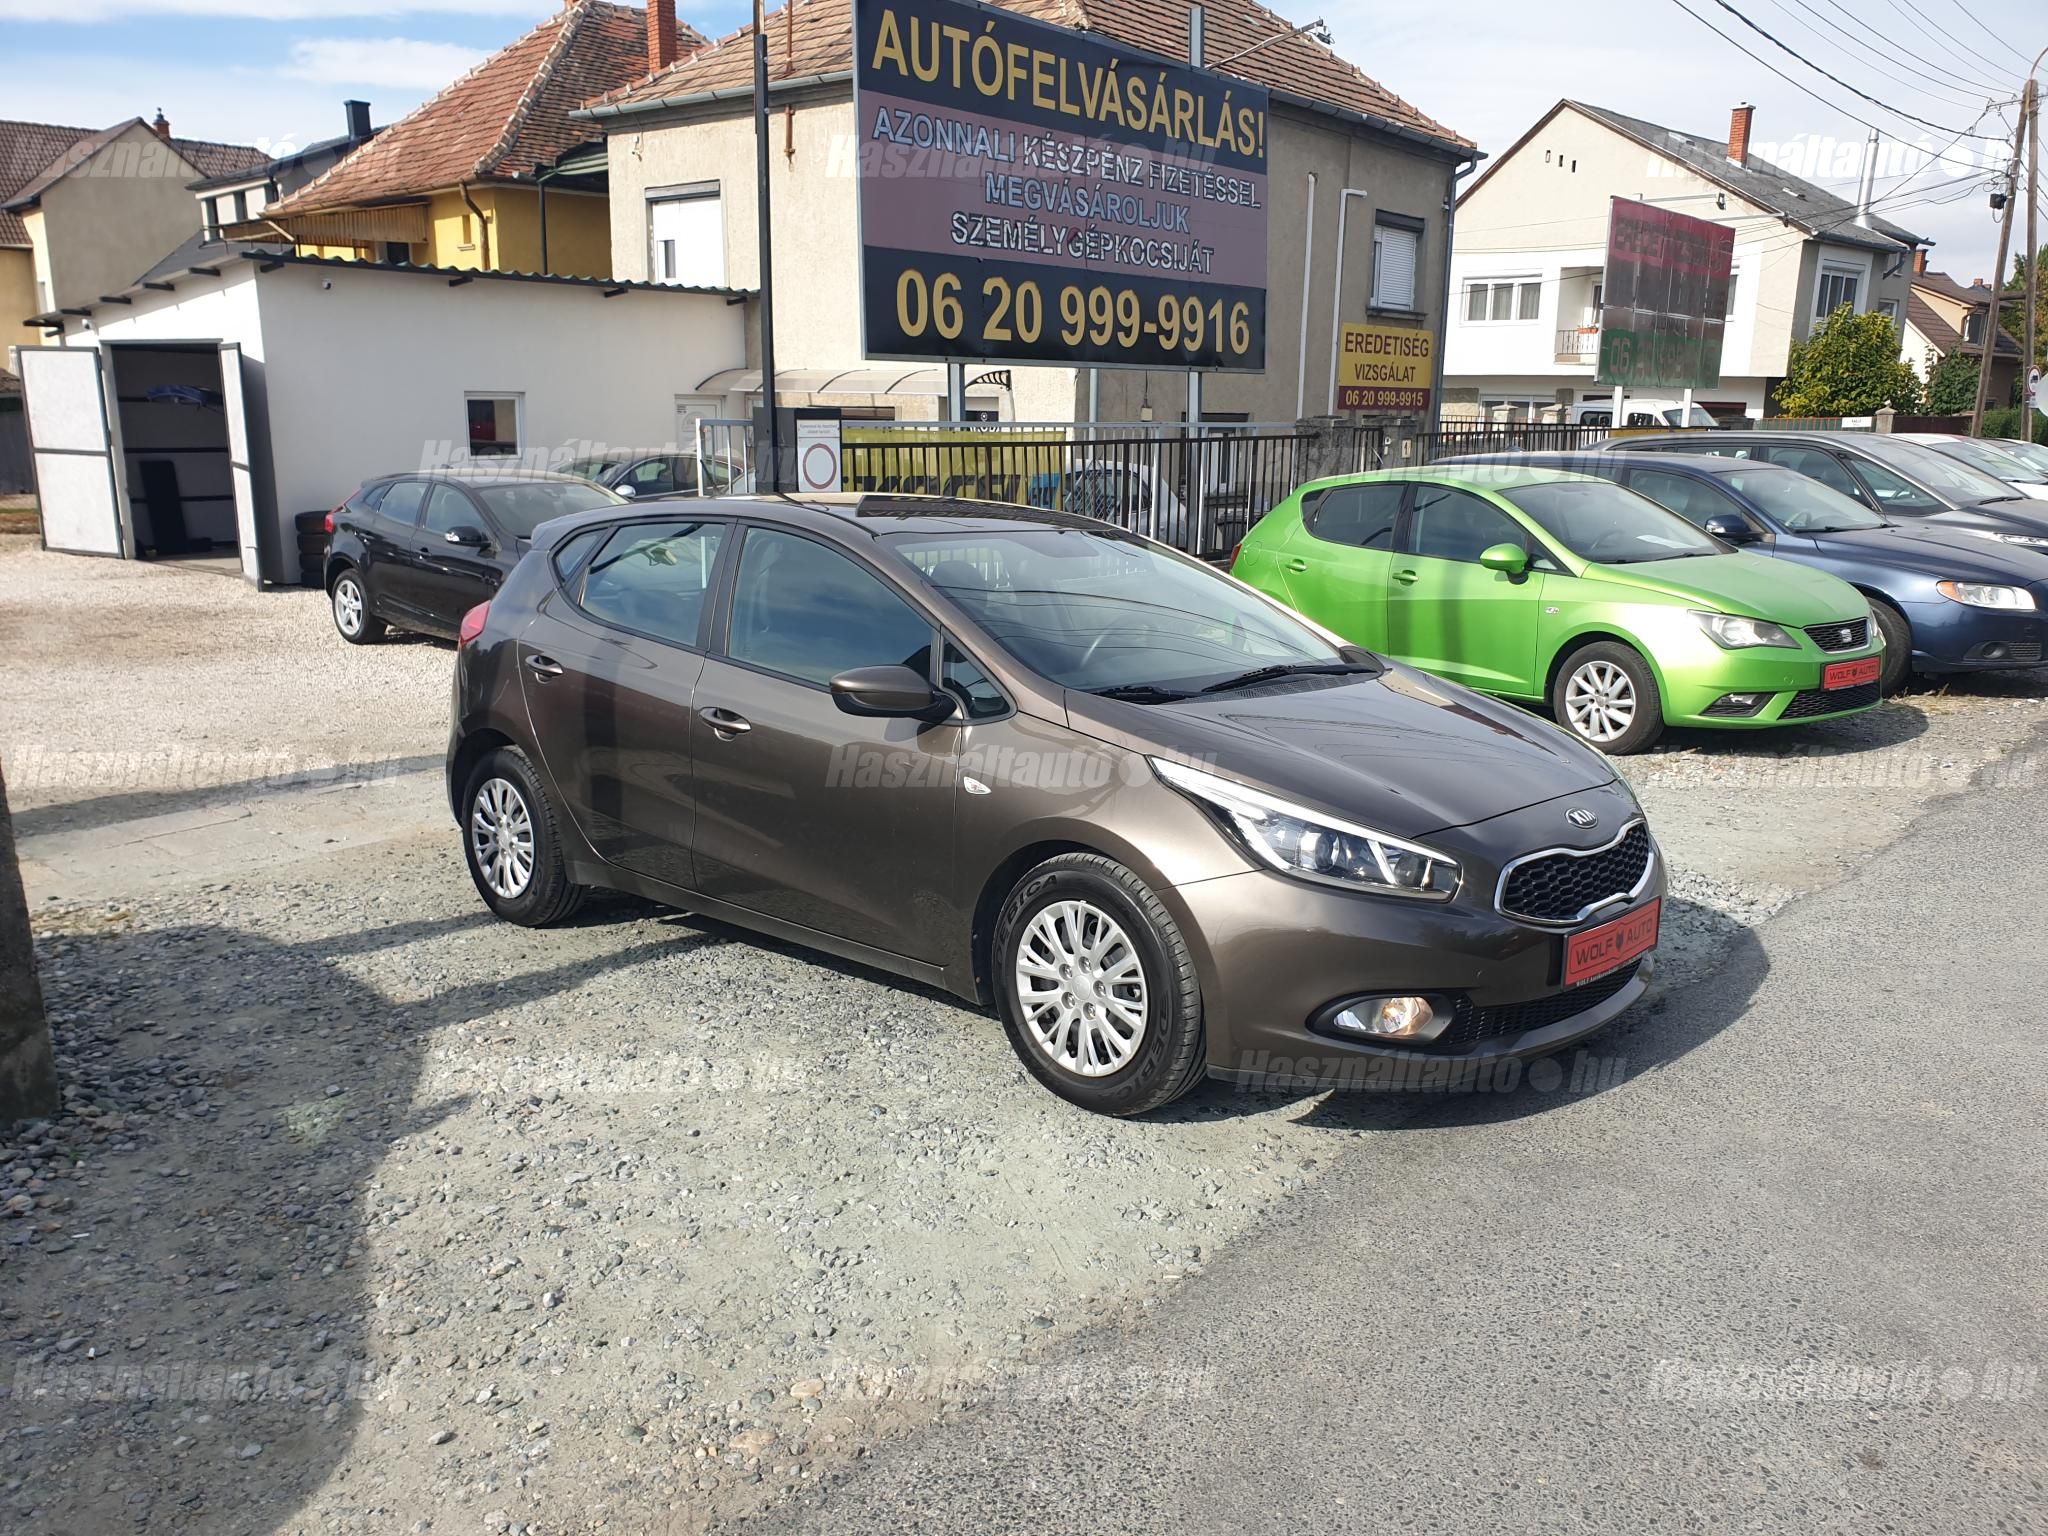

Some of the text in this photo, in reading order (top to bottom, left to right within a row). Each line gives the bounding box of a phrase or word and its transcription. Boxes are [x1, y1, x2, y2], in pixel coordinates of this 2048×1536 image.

[871, 8, 1265, 158] AUTÓFELVÁSÁRLÁS!
[872, 106, 1261, 209] AZONNALI KÉSZPÉNZ FIZETÉSSEL
[985, 171, 1190, 234] MEGVÁSÁROLJUK
[950, 211, 1215, 275] SZEMÉLYGÉPKOCSIJÁT
[896, 268, 1250, 355] 06 20 999-9916
[1344, 331, 1430, 358] EREDETISÉG
[1354, 361, 1417, 383] VIZSGÁLAT
[1345, 390, 1424, 407] 06 20 999-9915
[1829, 664, 1877, 681] WOLF AUTO
[1571, 809, 1597, 826] KIA
[1575, 917, 1653, 966] WOLF AUTO
